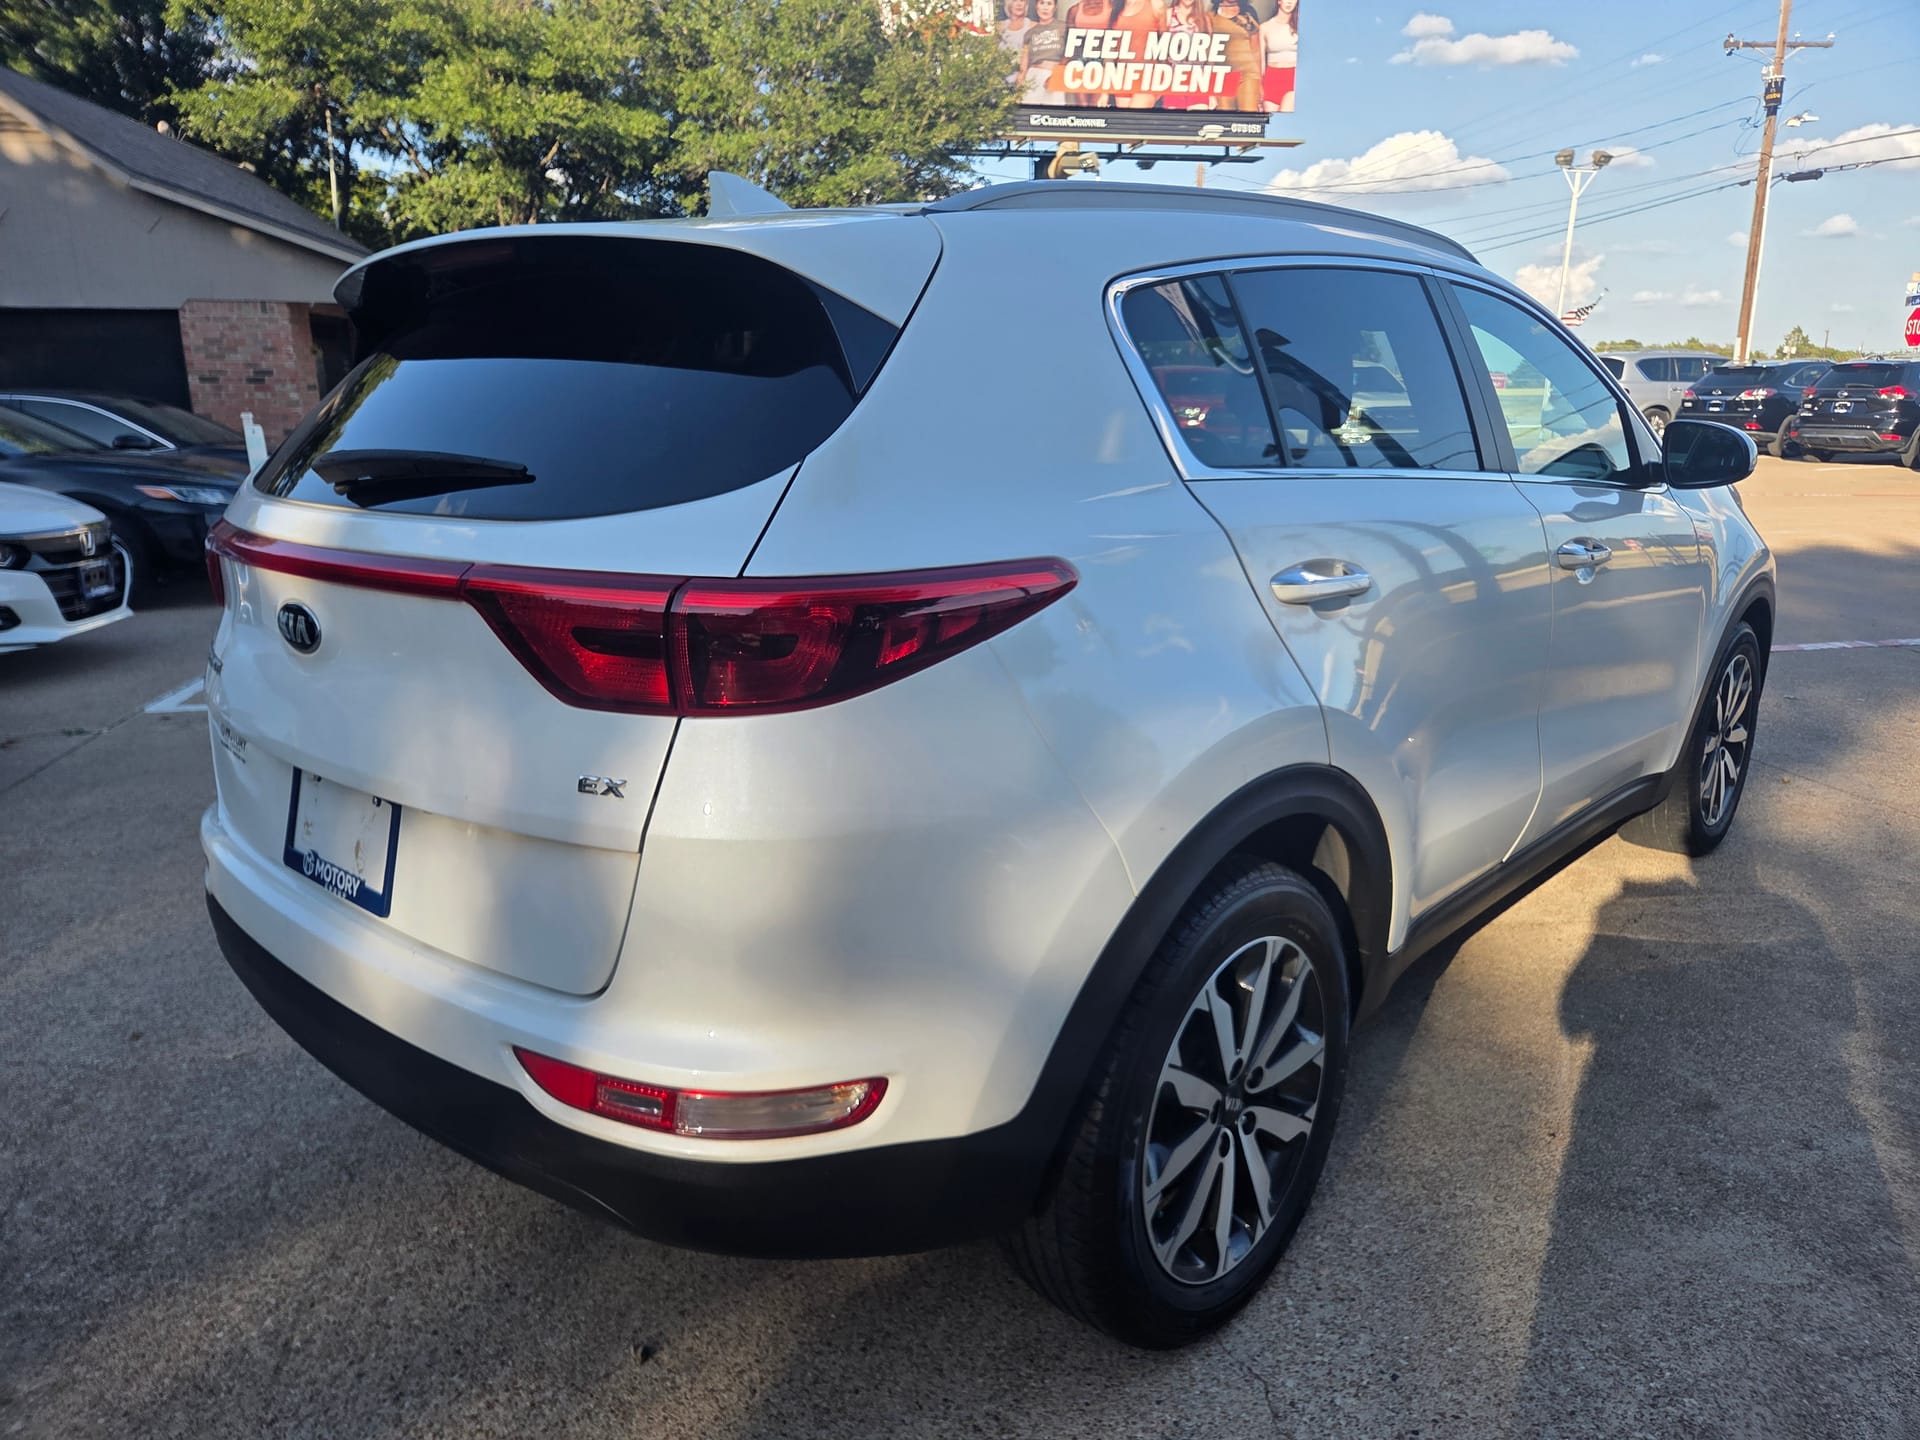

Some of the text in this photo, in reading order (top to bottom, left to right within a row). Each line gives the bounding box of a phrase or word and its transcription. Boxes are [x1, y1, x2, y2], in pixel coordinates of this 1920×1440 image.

[1064, 28, 1136, 59] FEEL
[1144, 31, 1230, 62] MORE
[1063, 60, 1232, 93] CONFIDENT
[279, 610, 311, 645] KIA
[577, 775, 628, 799] EX
[315, 857, 361, 898] MOTORY
